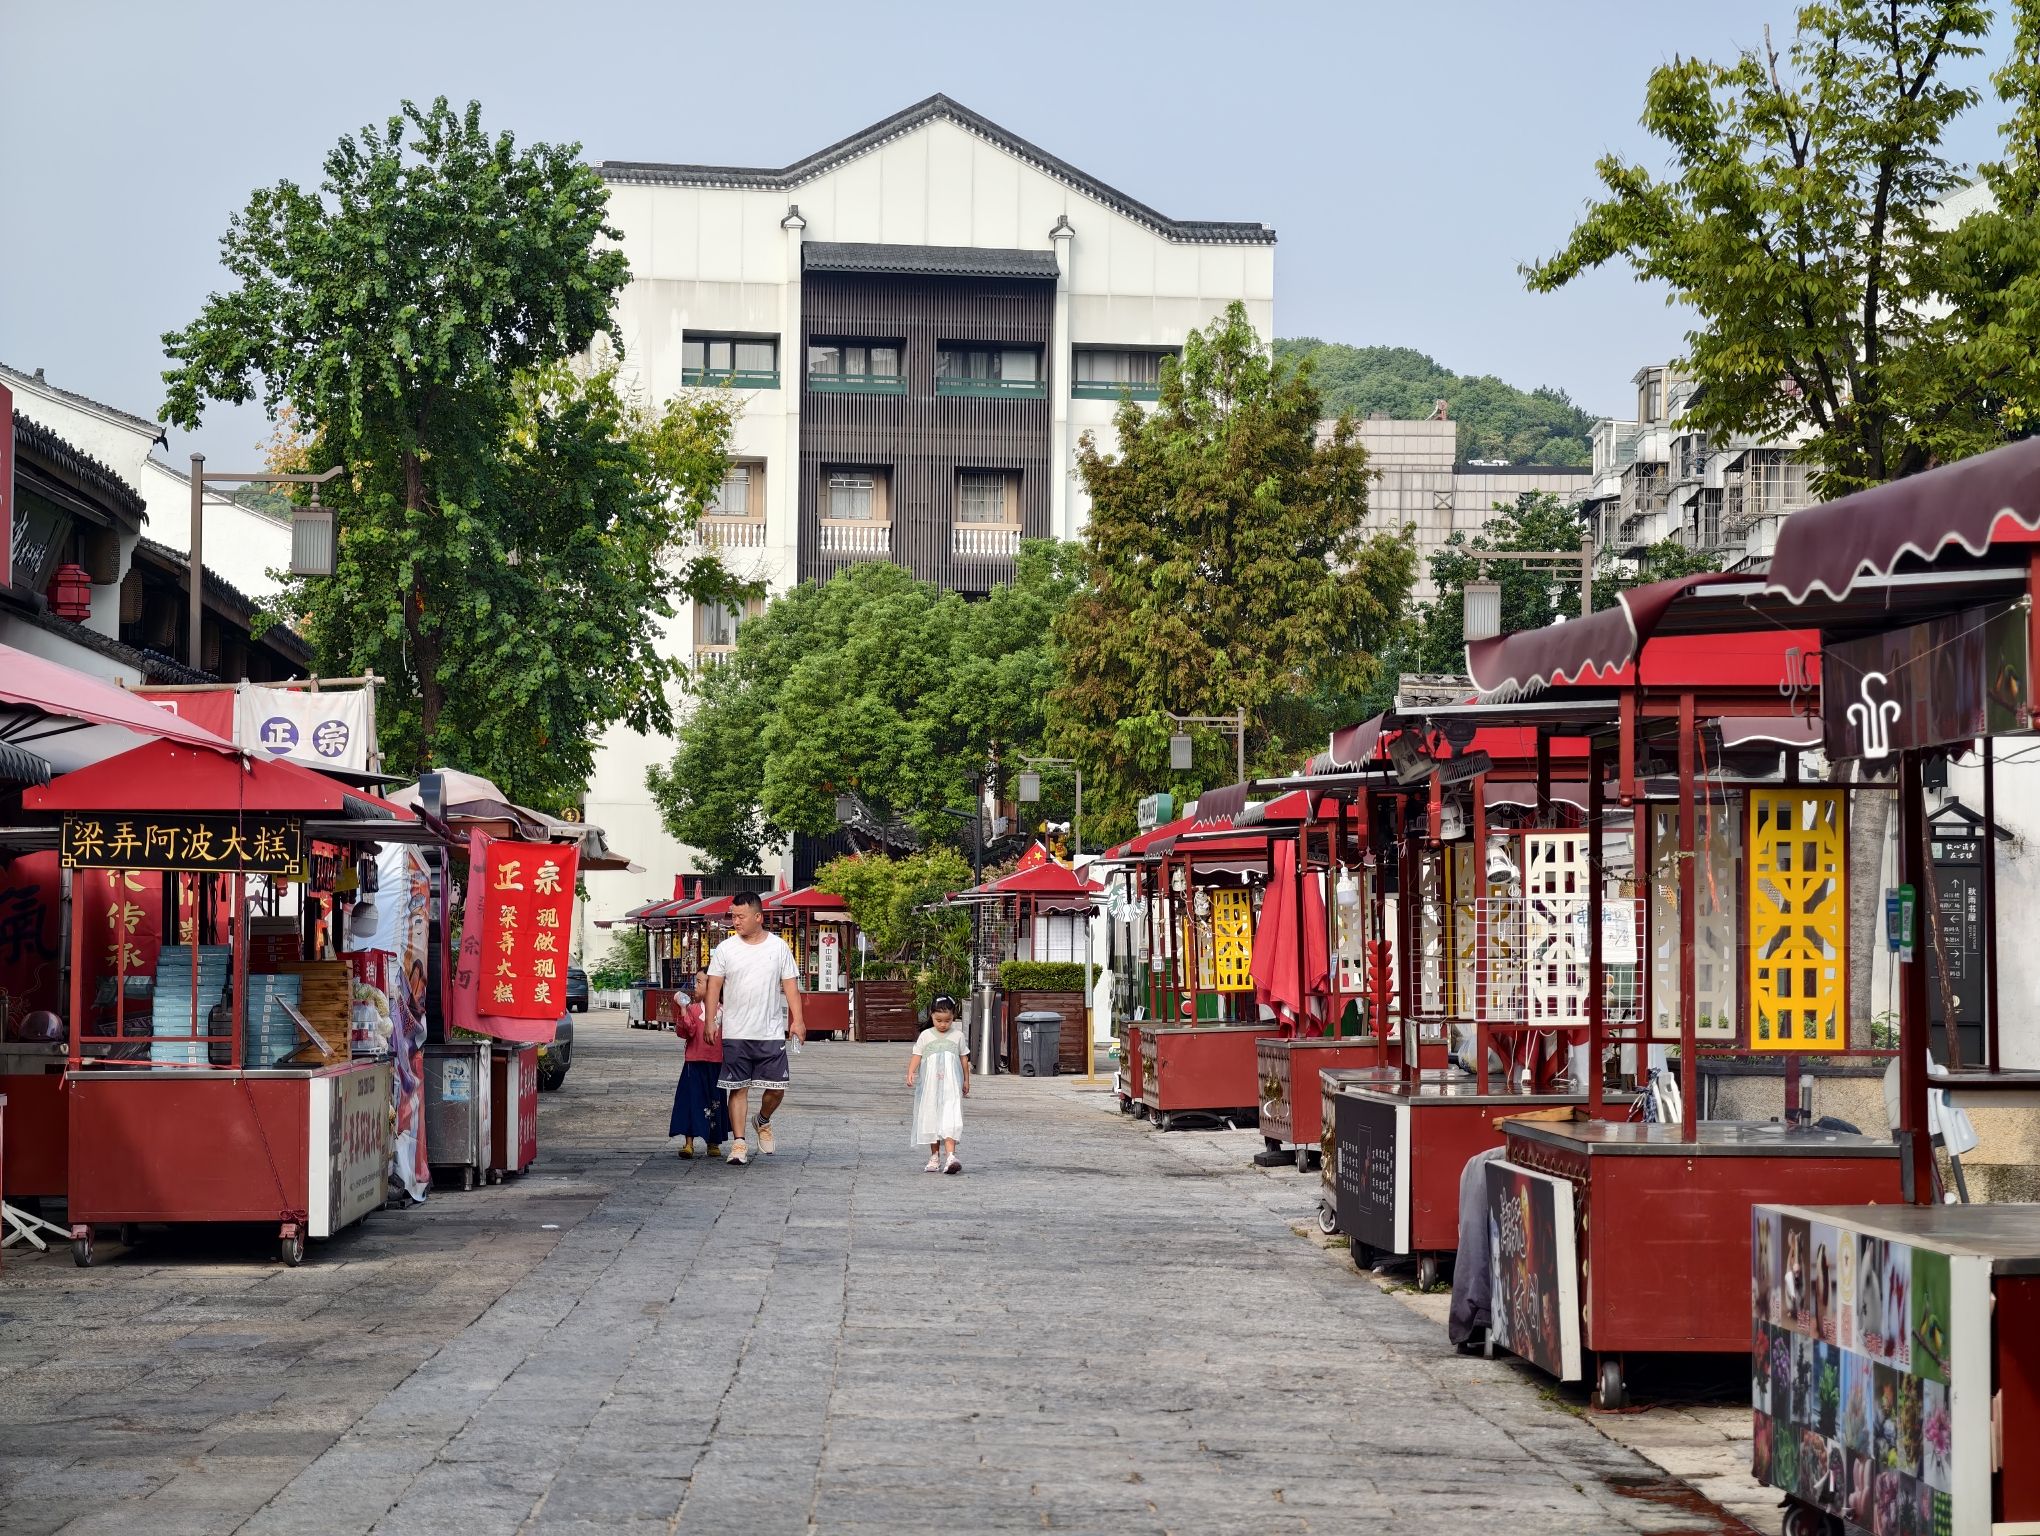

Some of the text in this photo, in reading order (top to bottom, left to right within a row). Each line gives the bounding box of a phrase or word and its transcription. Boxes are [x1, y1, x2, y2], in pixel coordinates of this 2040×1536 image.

[262, 721, 349, 756] 正宗
[71, 819, 291, 862] 梁弄阿波大糕
[493, 860, 563, 895] 正宗
[1967, 887, 1977, 922] 秋雨书屋
[532, 908, 561, 1005] 现做现卖
